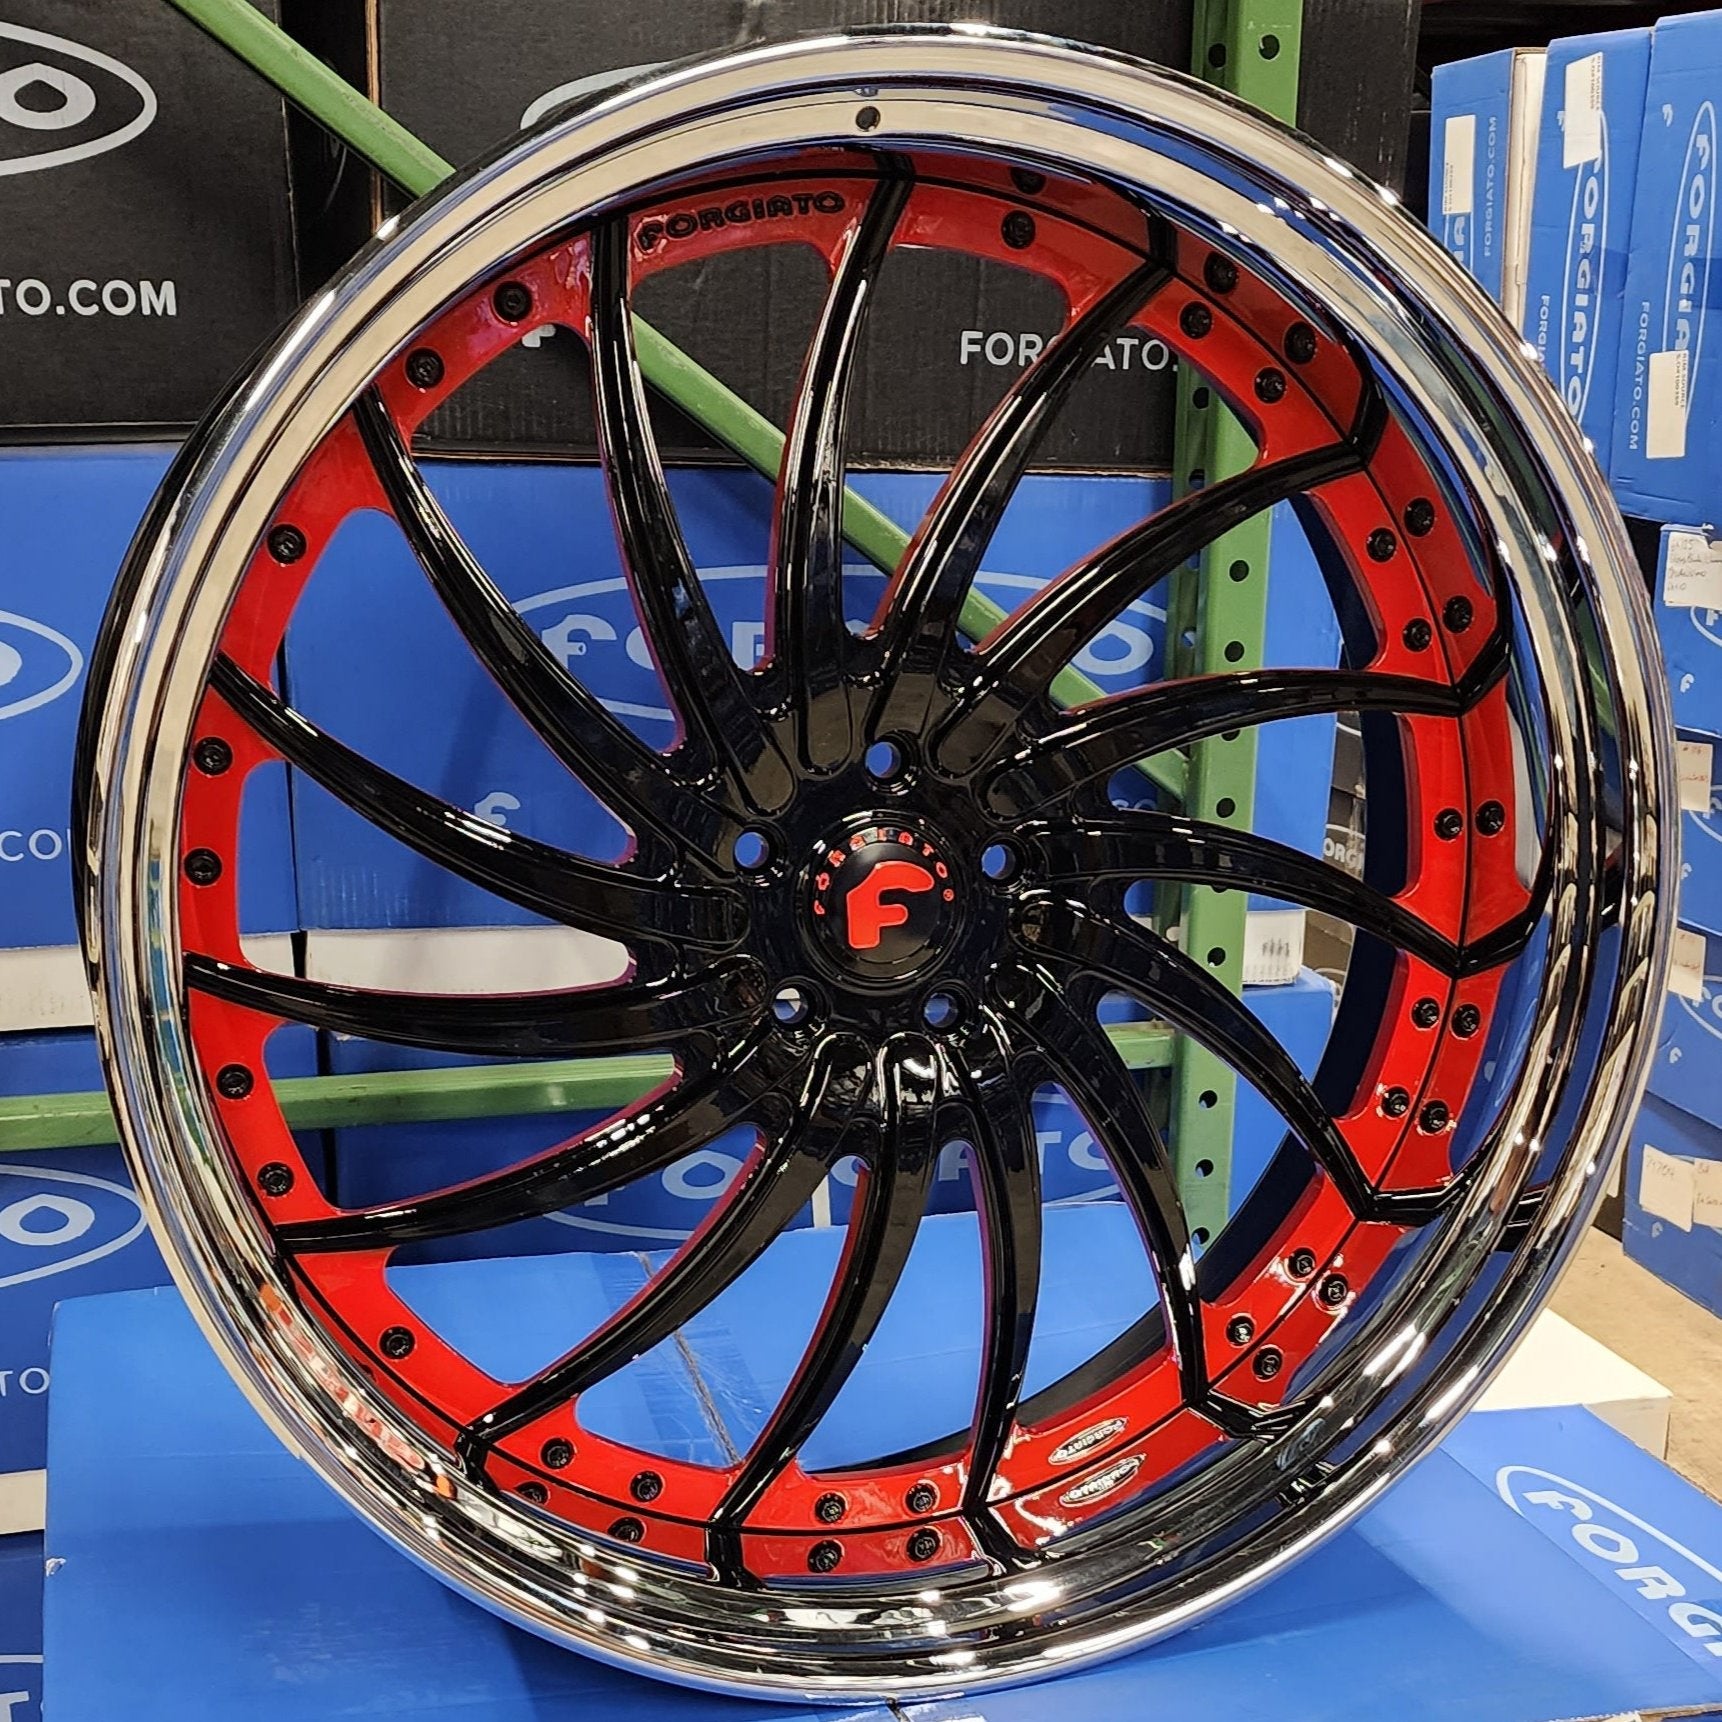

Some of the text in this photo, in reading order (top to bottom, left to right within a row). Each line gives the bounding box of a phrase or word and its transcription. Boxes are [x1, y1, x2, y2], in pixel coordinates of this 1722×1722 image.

[633, 190, 845, 253] FORGIATO
[1484, 117, 1497, 257] FORGIATO.COM
[1674, 134, 1710, 351] FORGIA
[960, 330, 1178, 371] FORATO.
[1629, 301, 1650, 450] FORGIATO.COM
[847, 860, 935, 949] F
